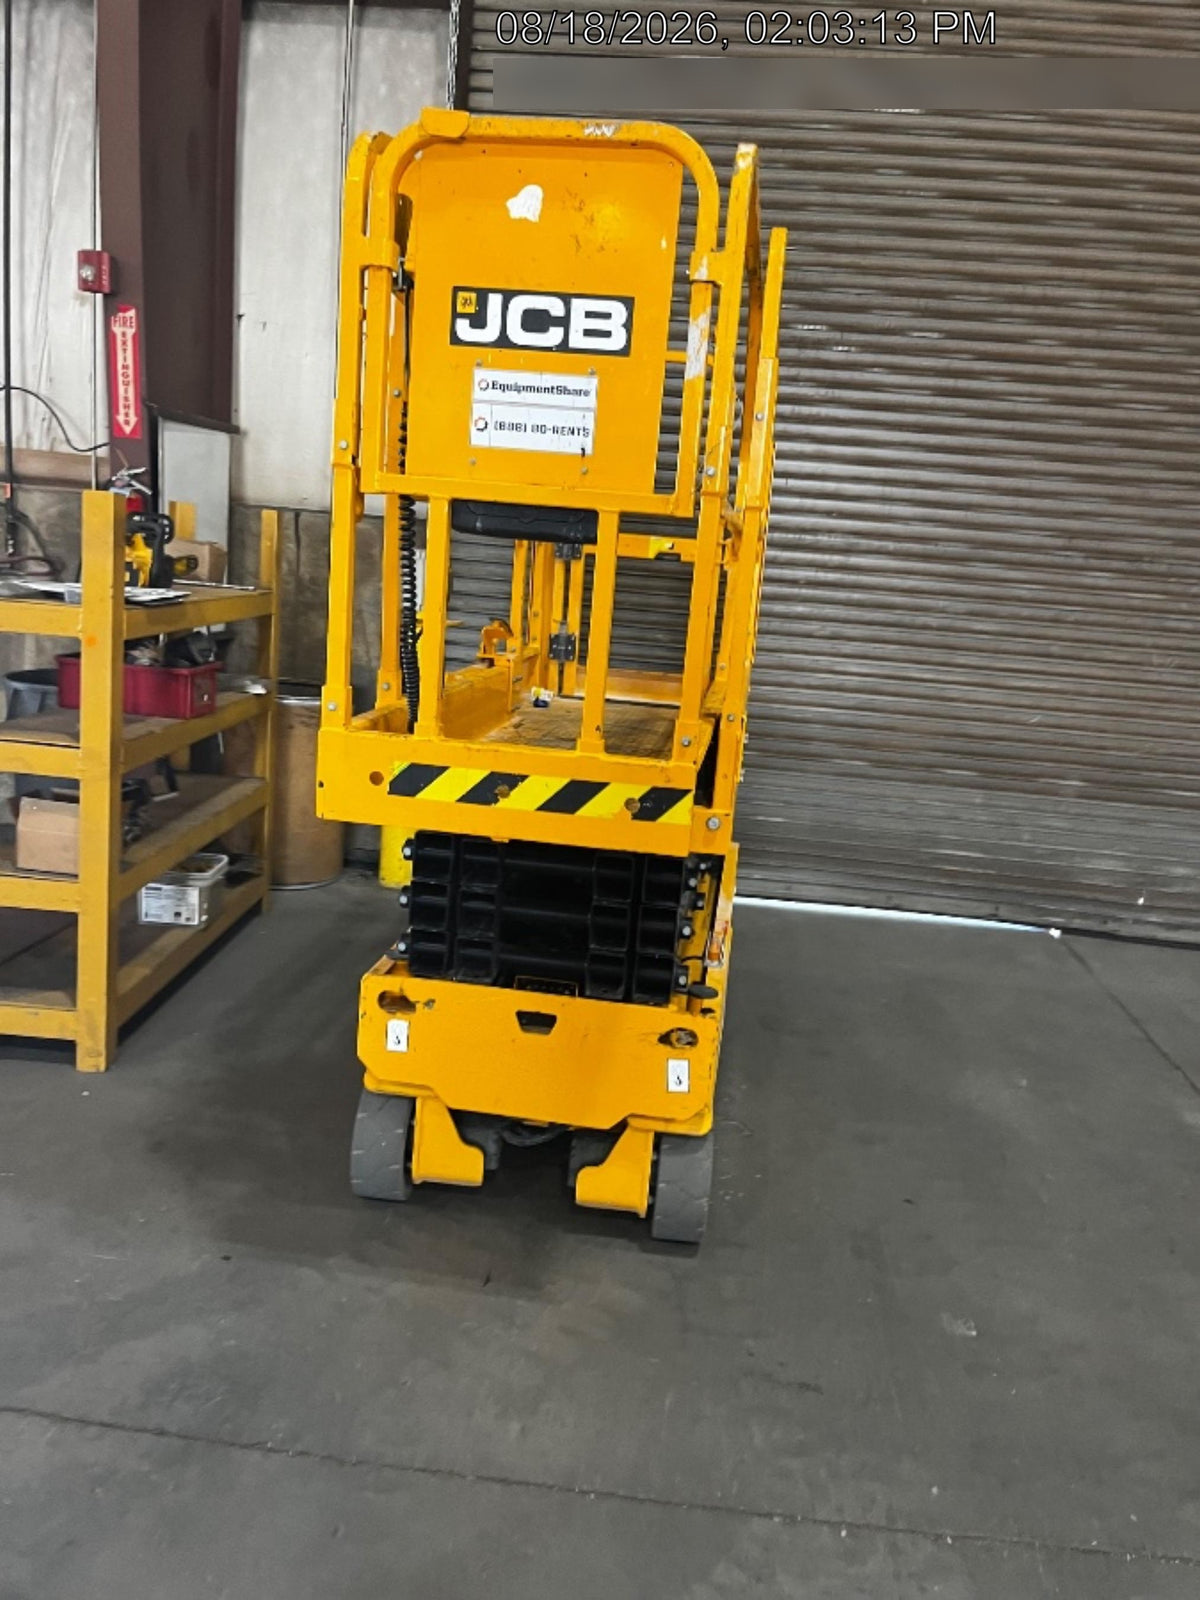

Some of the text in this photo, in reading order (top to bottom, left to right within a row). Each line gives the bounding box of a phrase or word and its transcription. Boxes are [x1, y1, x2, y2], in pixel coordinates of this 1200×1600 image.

[113, 315, 135, 328] FIRE
[455, 292, 628, 351] JCB
[121, 330, 131, 426] EXTINGUISHER
[491, 380, 590, 397] EquipmentShare
